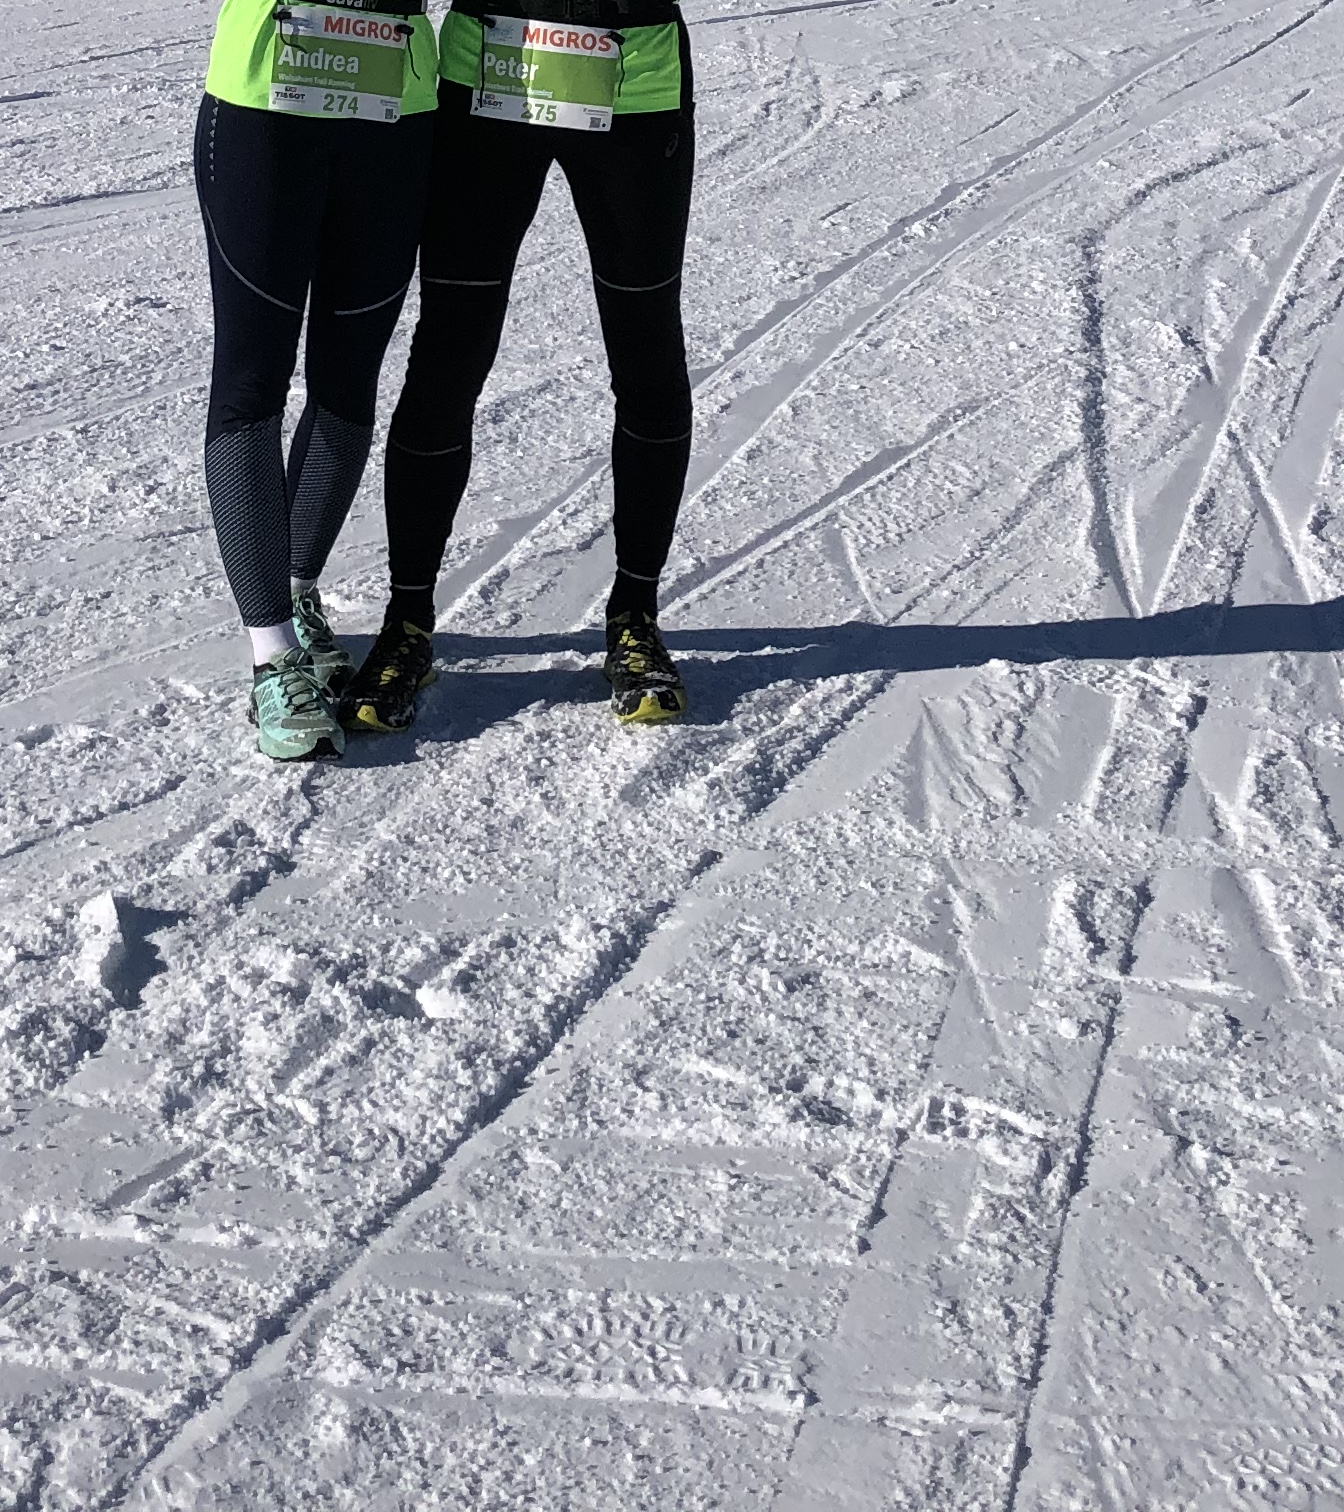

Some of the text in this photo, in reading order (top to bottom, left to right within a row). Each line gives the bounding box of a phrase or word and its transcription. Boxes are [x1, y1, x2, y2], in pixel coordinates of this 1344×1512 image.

[323, 15, 403, 43] MIGROS
[522, 26, 612, 52] MIGROS
[277, 45, 359, 74] Andrea
[484, 52, 539, 81] Peter
[274, 91, 306, 100] TISSOT
[322, 94, 359, 115] 274
[476, 97, 503, 107] TSSOT
[521, 101, 557, 123] 275
